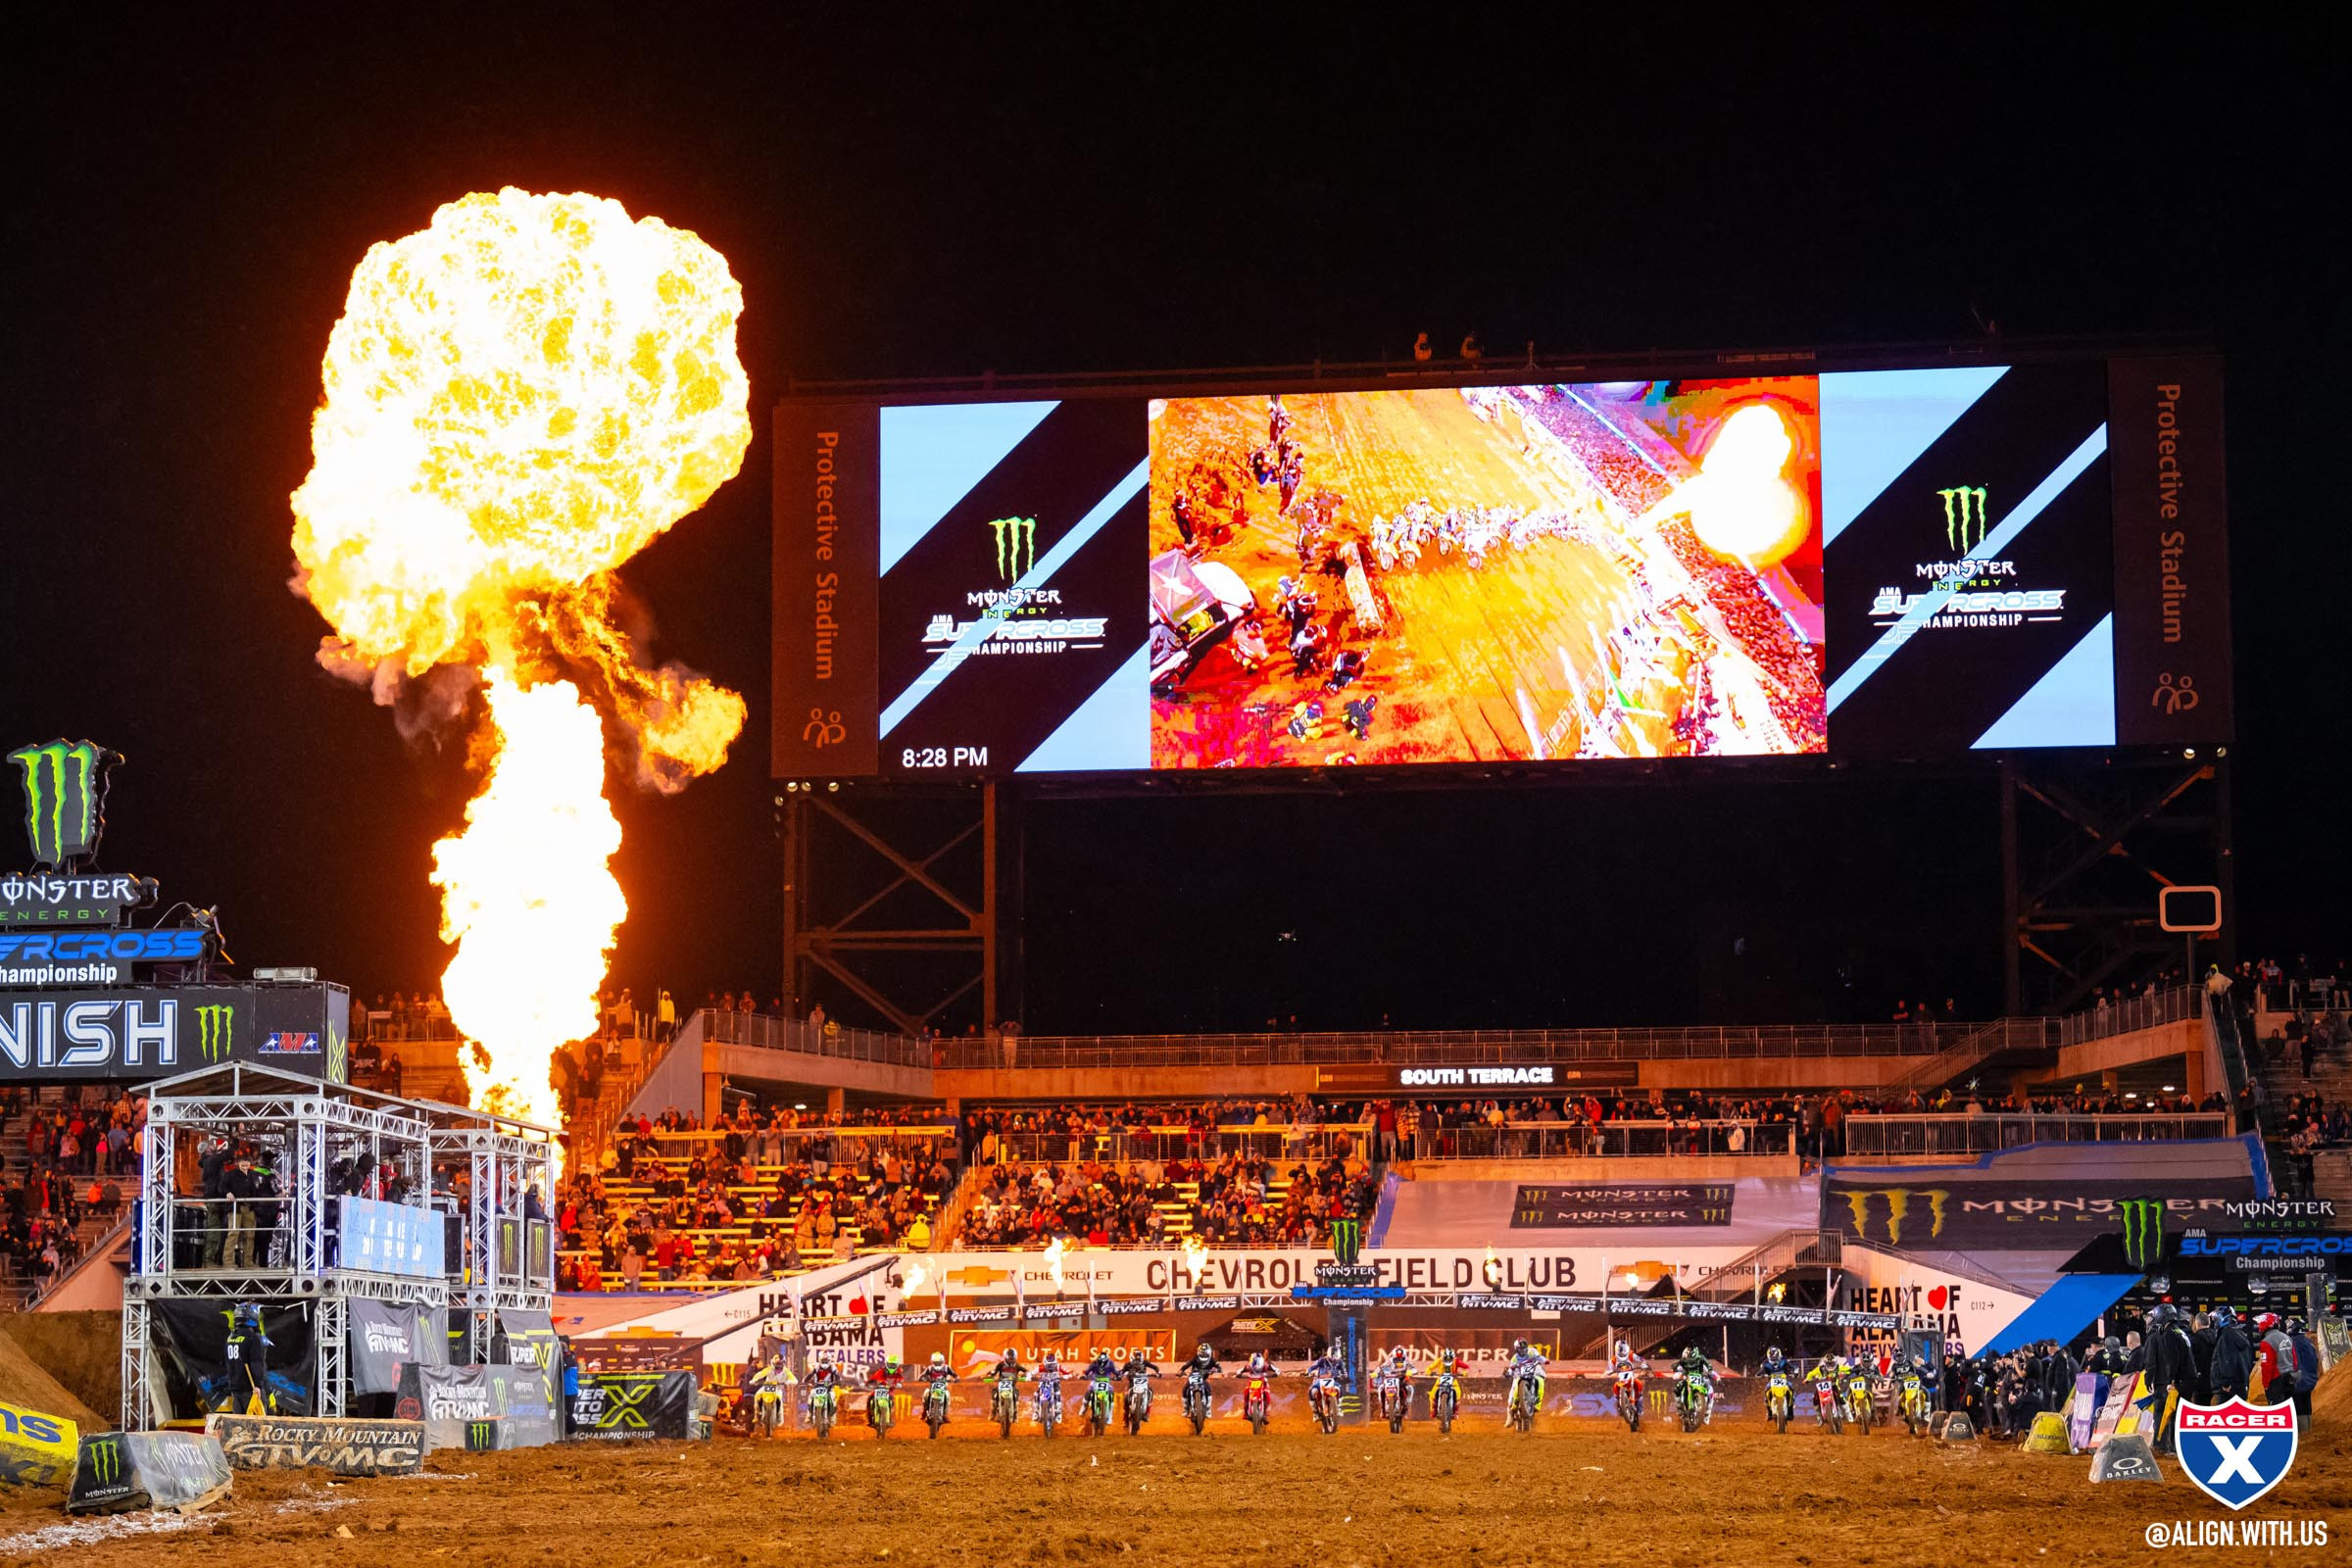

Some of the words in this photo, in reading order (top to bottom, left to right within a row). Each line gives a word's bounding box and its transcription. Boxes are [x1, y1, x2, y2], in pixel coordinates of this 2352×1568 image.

[2157, 384, 2184, 519] Protective
[816, 431, 839, 561] Protective
[1880, 586, 1901, 597] AMA
[2160, 530, 2187, 643] Stadium
[1868, 590, 2067, 615] SURCROSS
[815, 572, 839, 679] Stadium
[932, 614, 954, 624] AMA
[1923, 614, 2023, 628] HAMPIONSHIP
[921, 617, 1108, 643] SURCROSS
[972, 641, 1067, 655] HAMPIONSHIP
[902, 748, 948, 767] 8:28
[954, 747, 988, 766] PM
[0, 876, 133, 906] ONSTER
[1400, 1068, 1465, 1085] SOUTH
[1468, 1067, 1553, 1084] TERRACE
[1561, 1189, 1692, 1199] MONSTER
[1962, 1197, 2227, 1214] MONSER
[2227, 1199, 2335, 1218] MONSTER
[1557, 1209, 1689, 1220] MONSTER
[2006, 1213, 2201, 1222] ENEY
[2243, 1220, 2319, 1229] ENERGY
[2184, 1228, 2207, 1238] AMA
[2235, 1256, 2326, 1270] Championship
[1315, 1265, 1377, 1277] MONSTER
[1374, 1257, 1473, 1289] FIELD
[1483, 1256, 1576, 1288] CLUB
[1323, 1298, 1375, 1307] Championship
[1850, 1285, 1922, 1313] HEART
[1971, 1301, 1986, 1310] C112
[227, 1344, 239, 1359] 08
[1026, 1347, 1079, 1361] UTAH
[1377, 1344, 1510, 1362] MONTER
[1098, 1382, 1107, 1391] 9
[1442, 1376, 1451, 1385] 2
[1690, 1376, 1701, 1385] 21
[1818, 1382, 1830, 1391] 14
[257, 1424, 318, 1443] ROCKY
[323, 1426, 421, 1445] MOUNTAIN
[578, 1430, 656, 1441] CHAMPIONSHIP
[2106, 1466, 2151, 1479] OAKLEY
[85, 1486, 129, 1498] MONSTER
